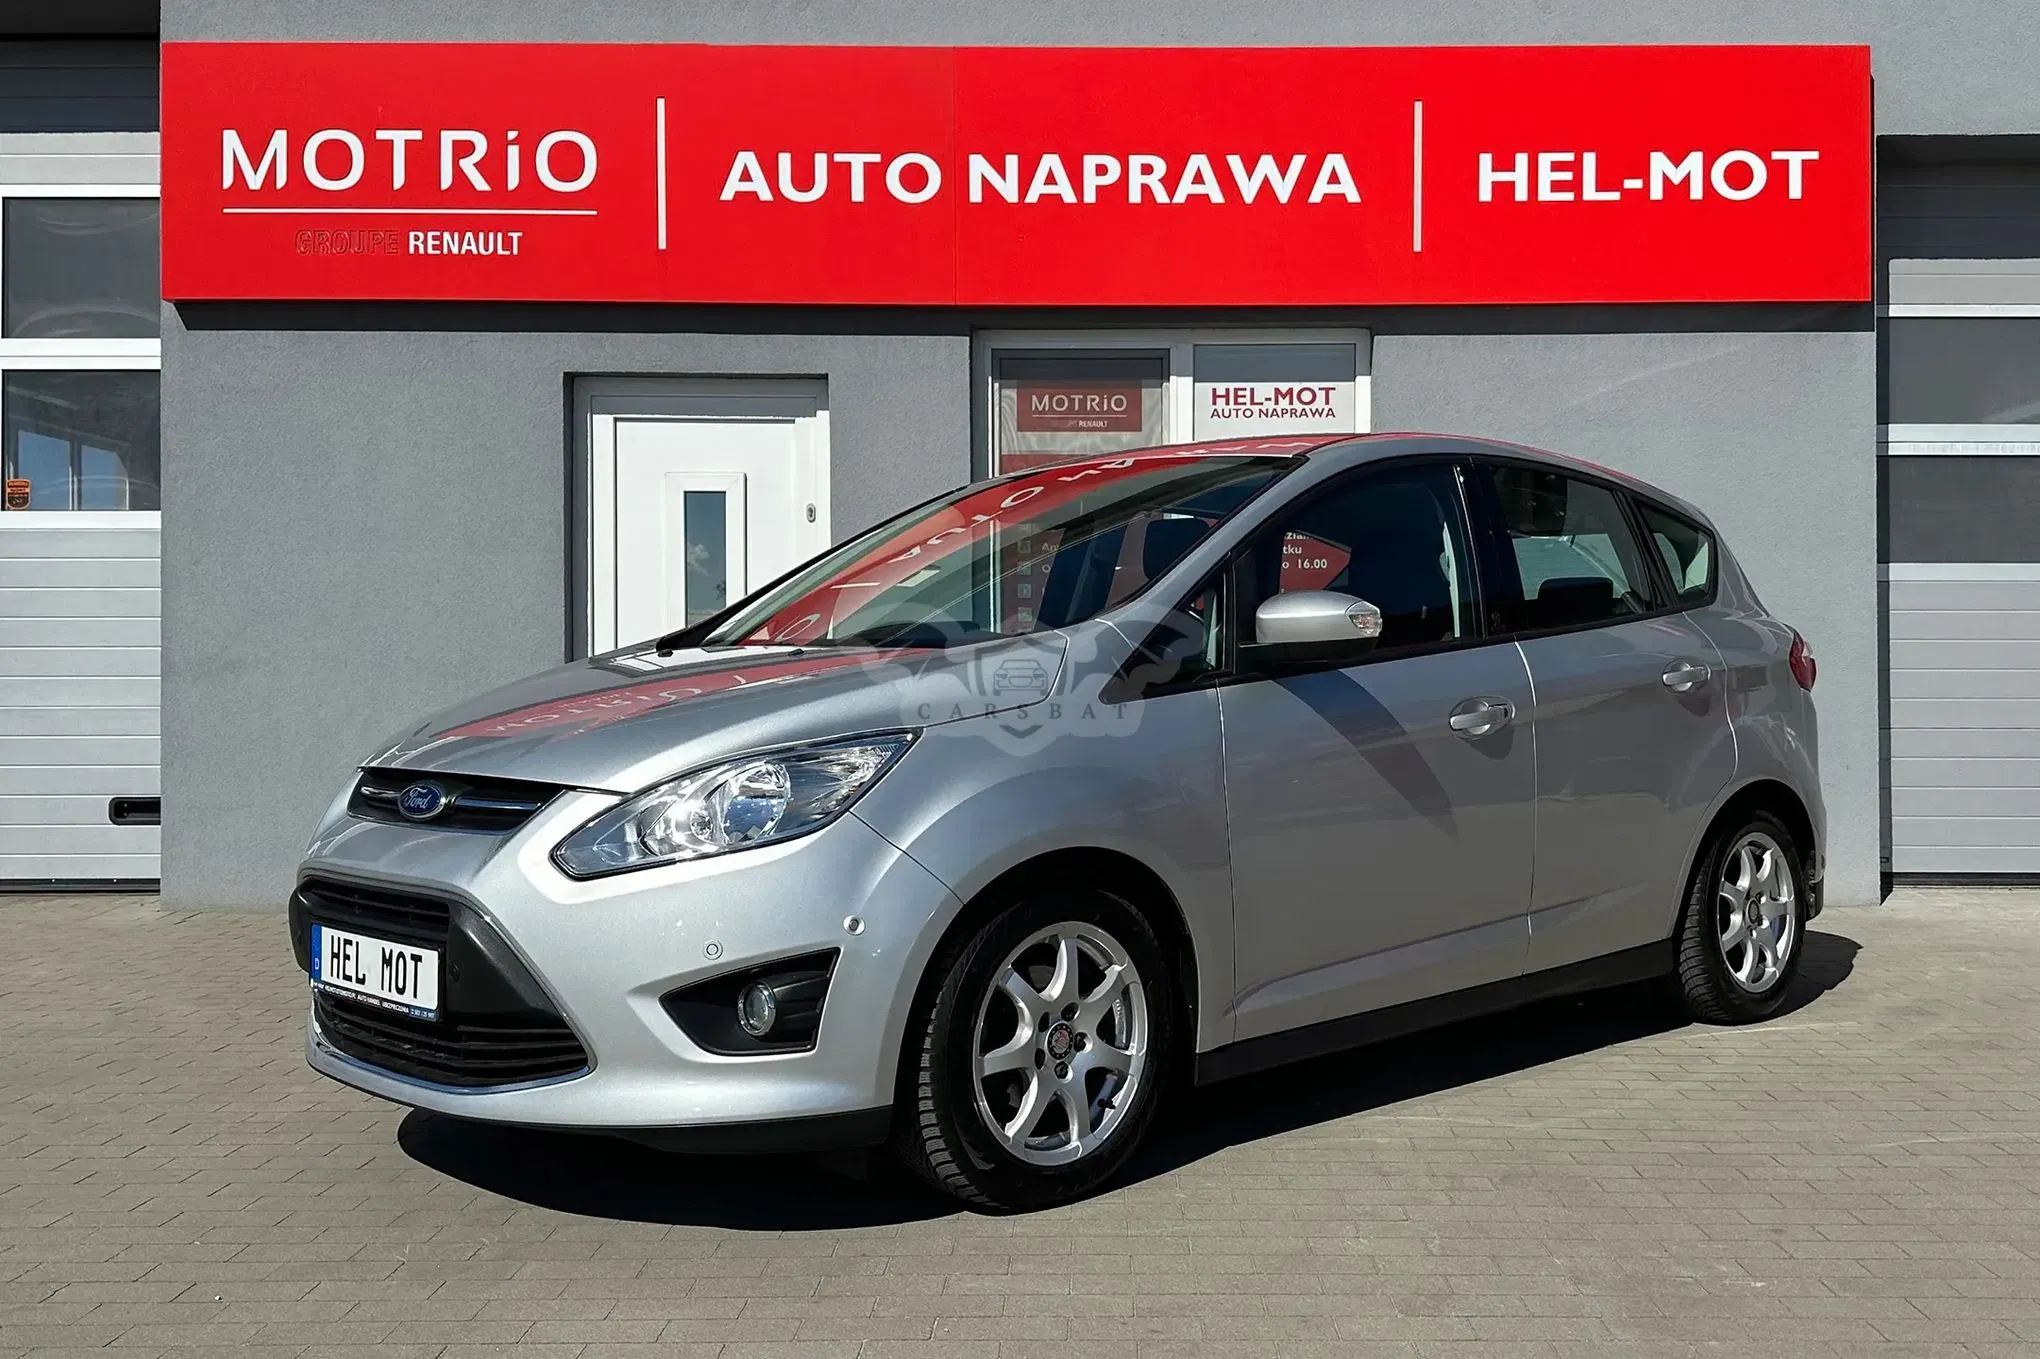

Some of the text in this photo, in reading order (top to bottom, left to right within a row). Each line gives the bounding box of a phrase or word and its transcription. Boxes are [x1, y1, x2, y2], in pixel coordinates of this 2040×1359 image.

[719, 151, 1362, 205] AUTO NAPRAWA
[1478, 150, 1820, 202] HEL-MOT
[295, 230, 523, 255] GROUPE RENAULT
[1211, 386, 1336, 406] HEL-MOT
[1210, 407, 1336, 419] AUTO NAPRAWA
[1297, 558, 1328, 569] 16.00
[404, 787, 432, 809] Ford
[330, 935, 423, 999] HEL MOT
